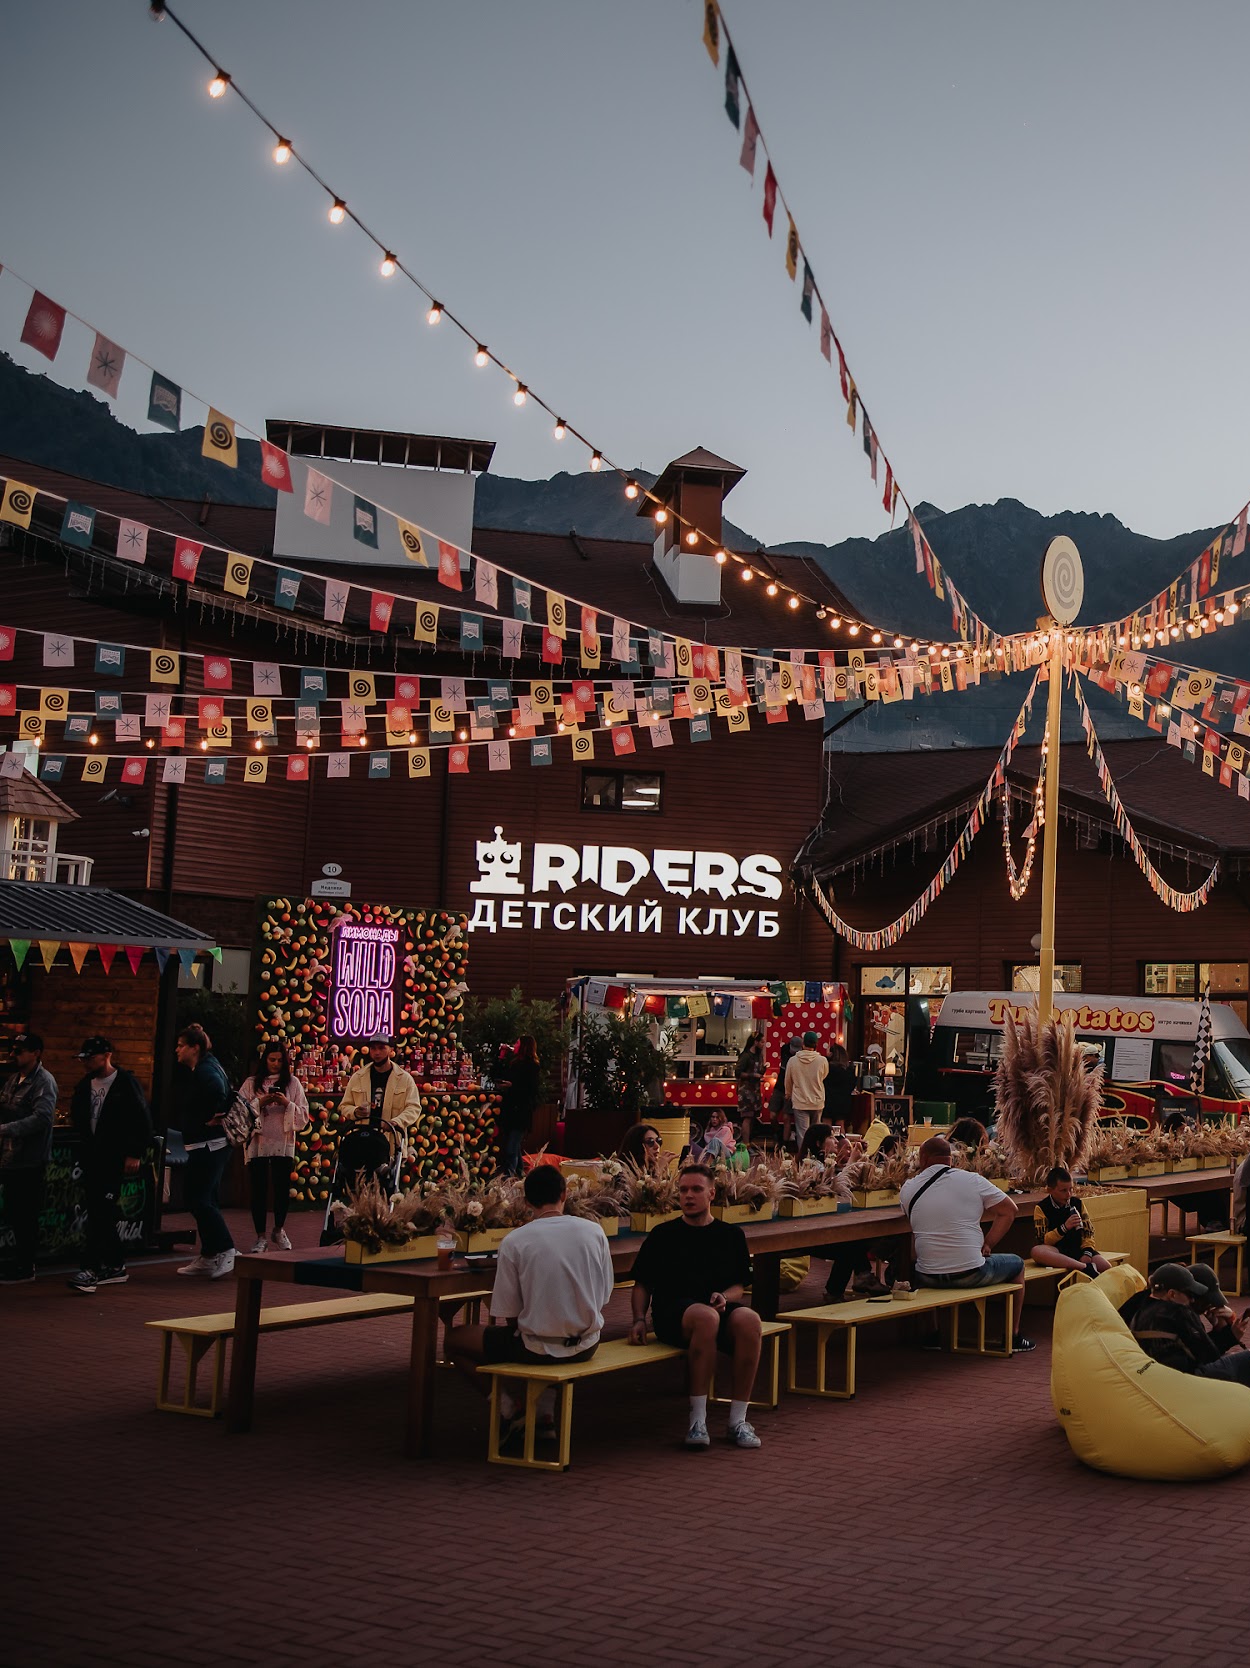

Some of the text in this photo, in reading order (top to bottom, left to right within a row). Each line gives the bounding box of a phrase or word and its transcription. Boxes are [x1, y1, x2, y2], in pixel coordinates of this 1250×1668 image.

[532, 842, 784, 901] RIDERS
[341, 926, 399, 942] ЛИМОНАДЫ
[467, 898, 781, 938] ДЕТСКИЙ КЛУБ
[336, 940, 396, 989] WILD
[333, 987, 394, 1037] SODA
